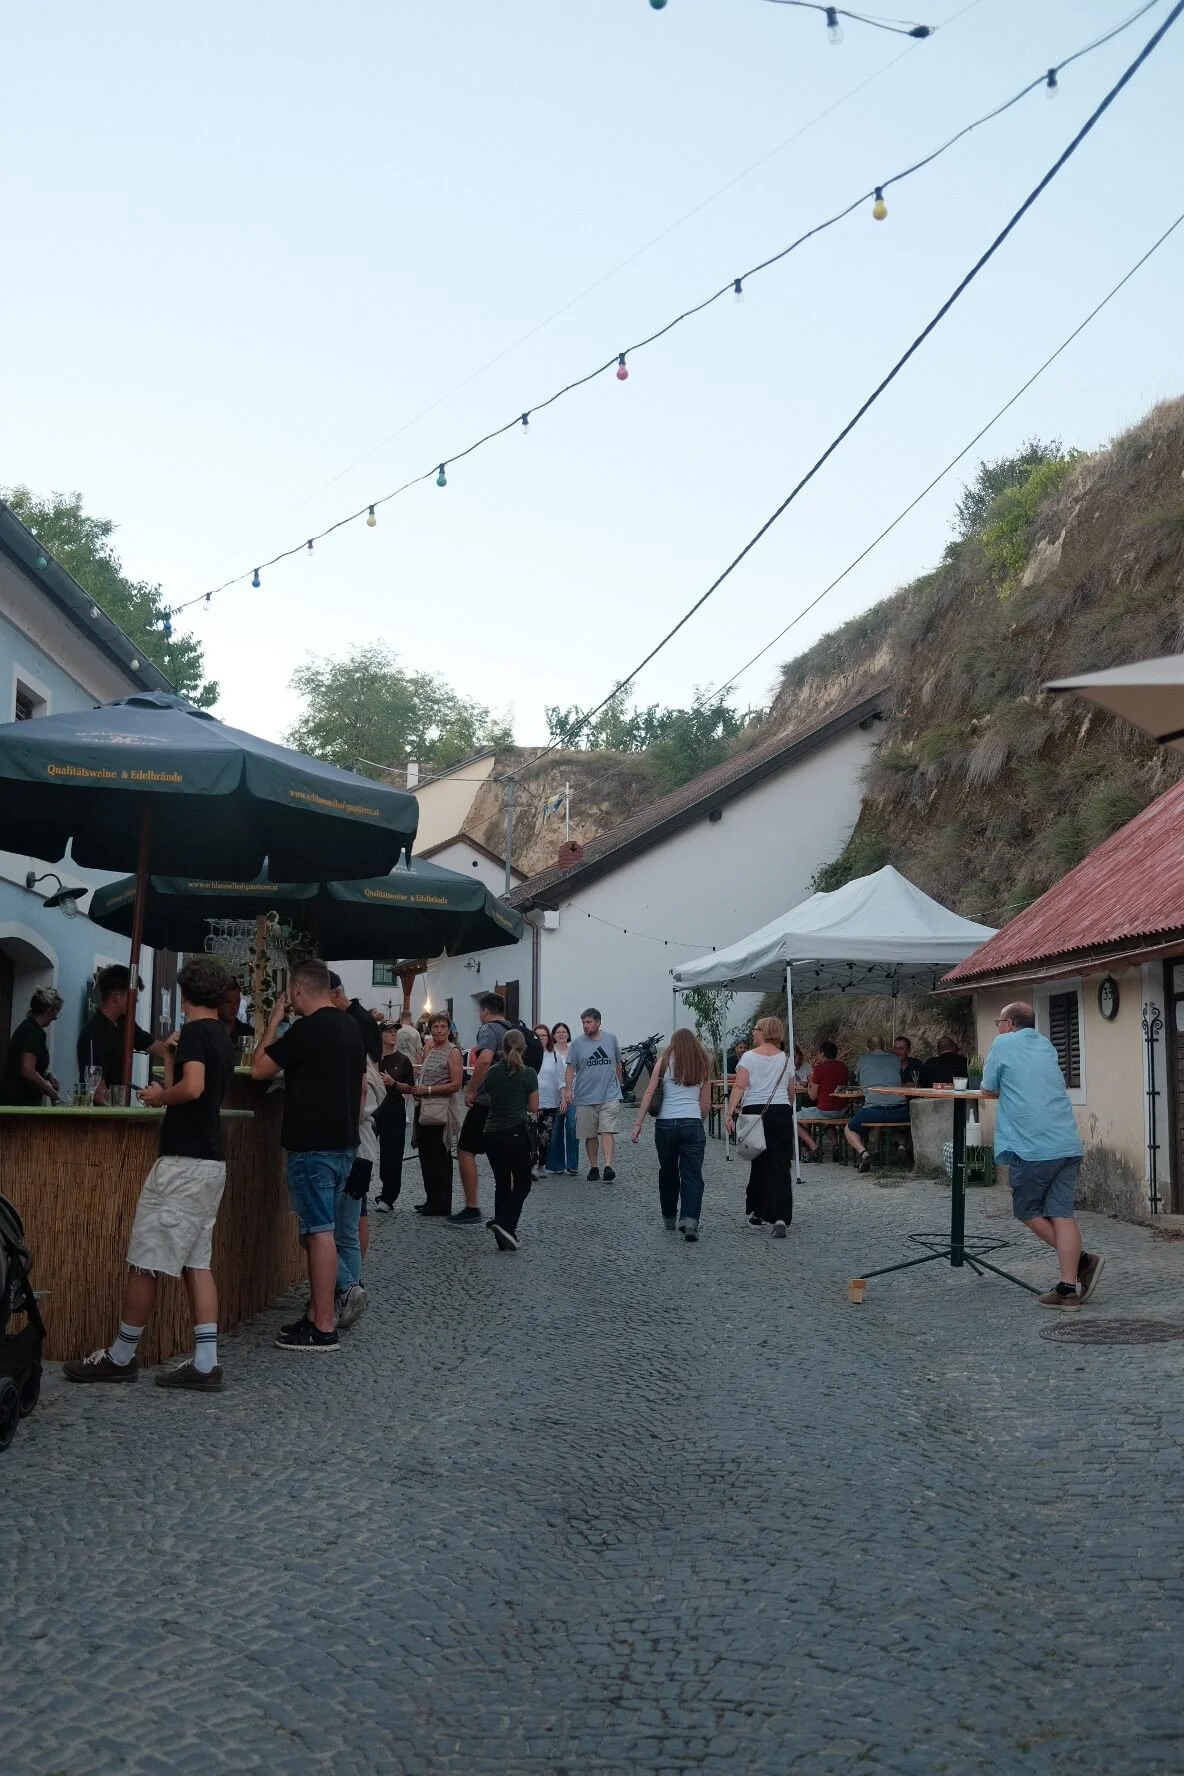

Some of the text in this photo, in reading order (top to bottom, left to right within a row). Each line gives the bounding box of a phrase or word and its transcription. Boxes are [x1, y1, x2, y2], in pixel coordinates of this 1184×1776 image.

[47, 764, 183, 782] Qualitätsweine & Edelbrände
[587, 1058, 612, 1067] adidas
